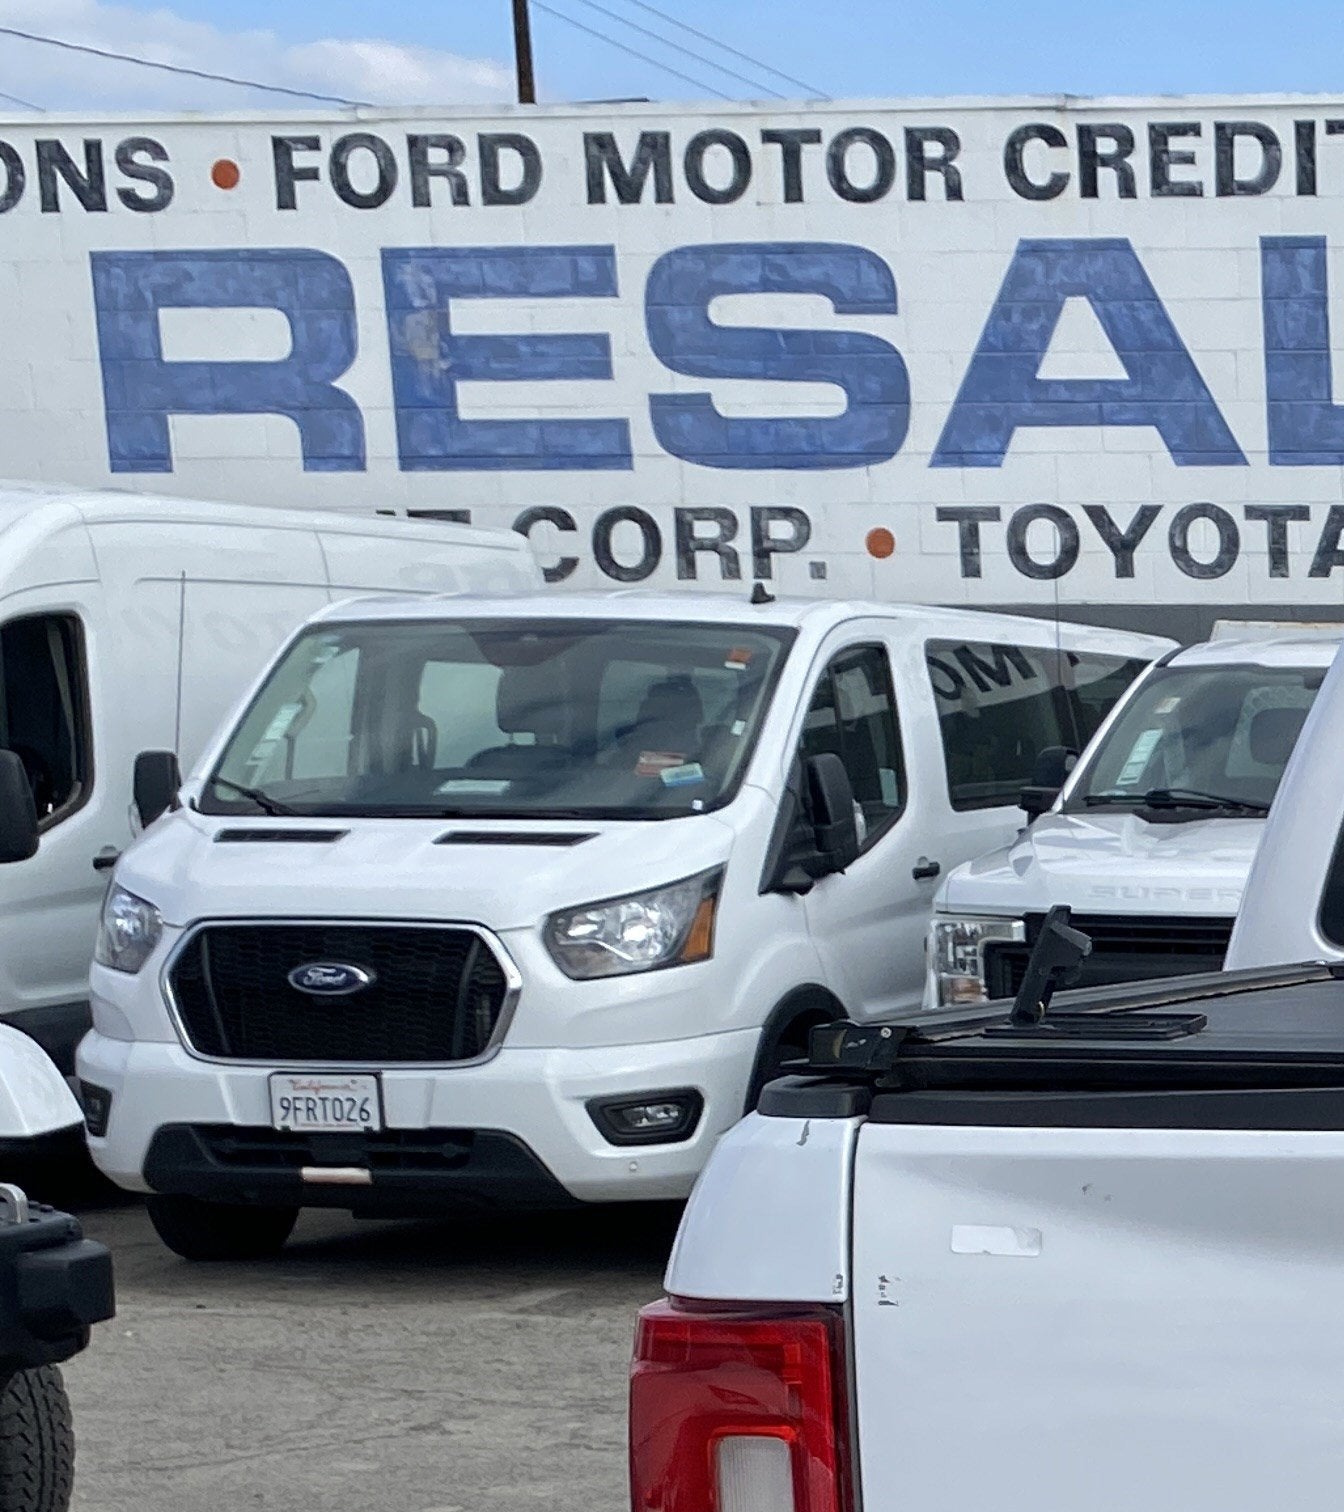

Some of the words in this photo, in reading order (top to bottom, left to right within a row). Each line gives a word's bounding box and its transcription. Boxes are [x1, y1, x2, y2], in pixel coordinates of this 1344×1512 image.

[271, 132, 542, 210] FORD
[583, 127, 964, 205] MOTOR
[512, 505, 827, 582] CORP.
[279, 1096, 371, 1123] 9FRT026
